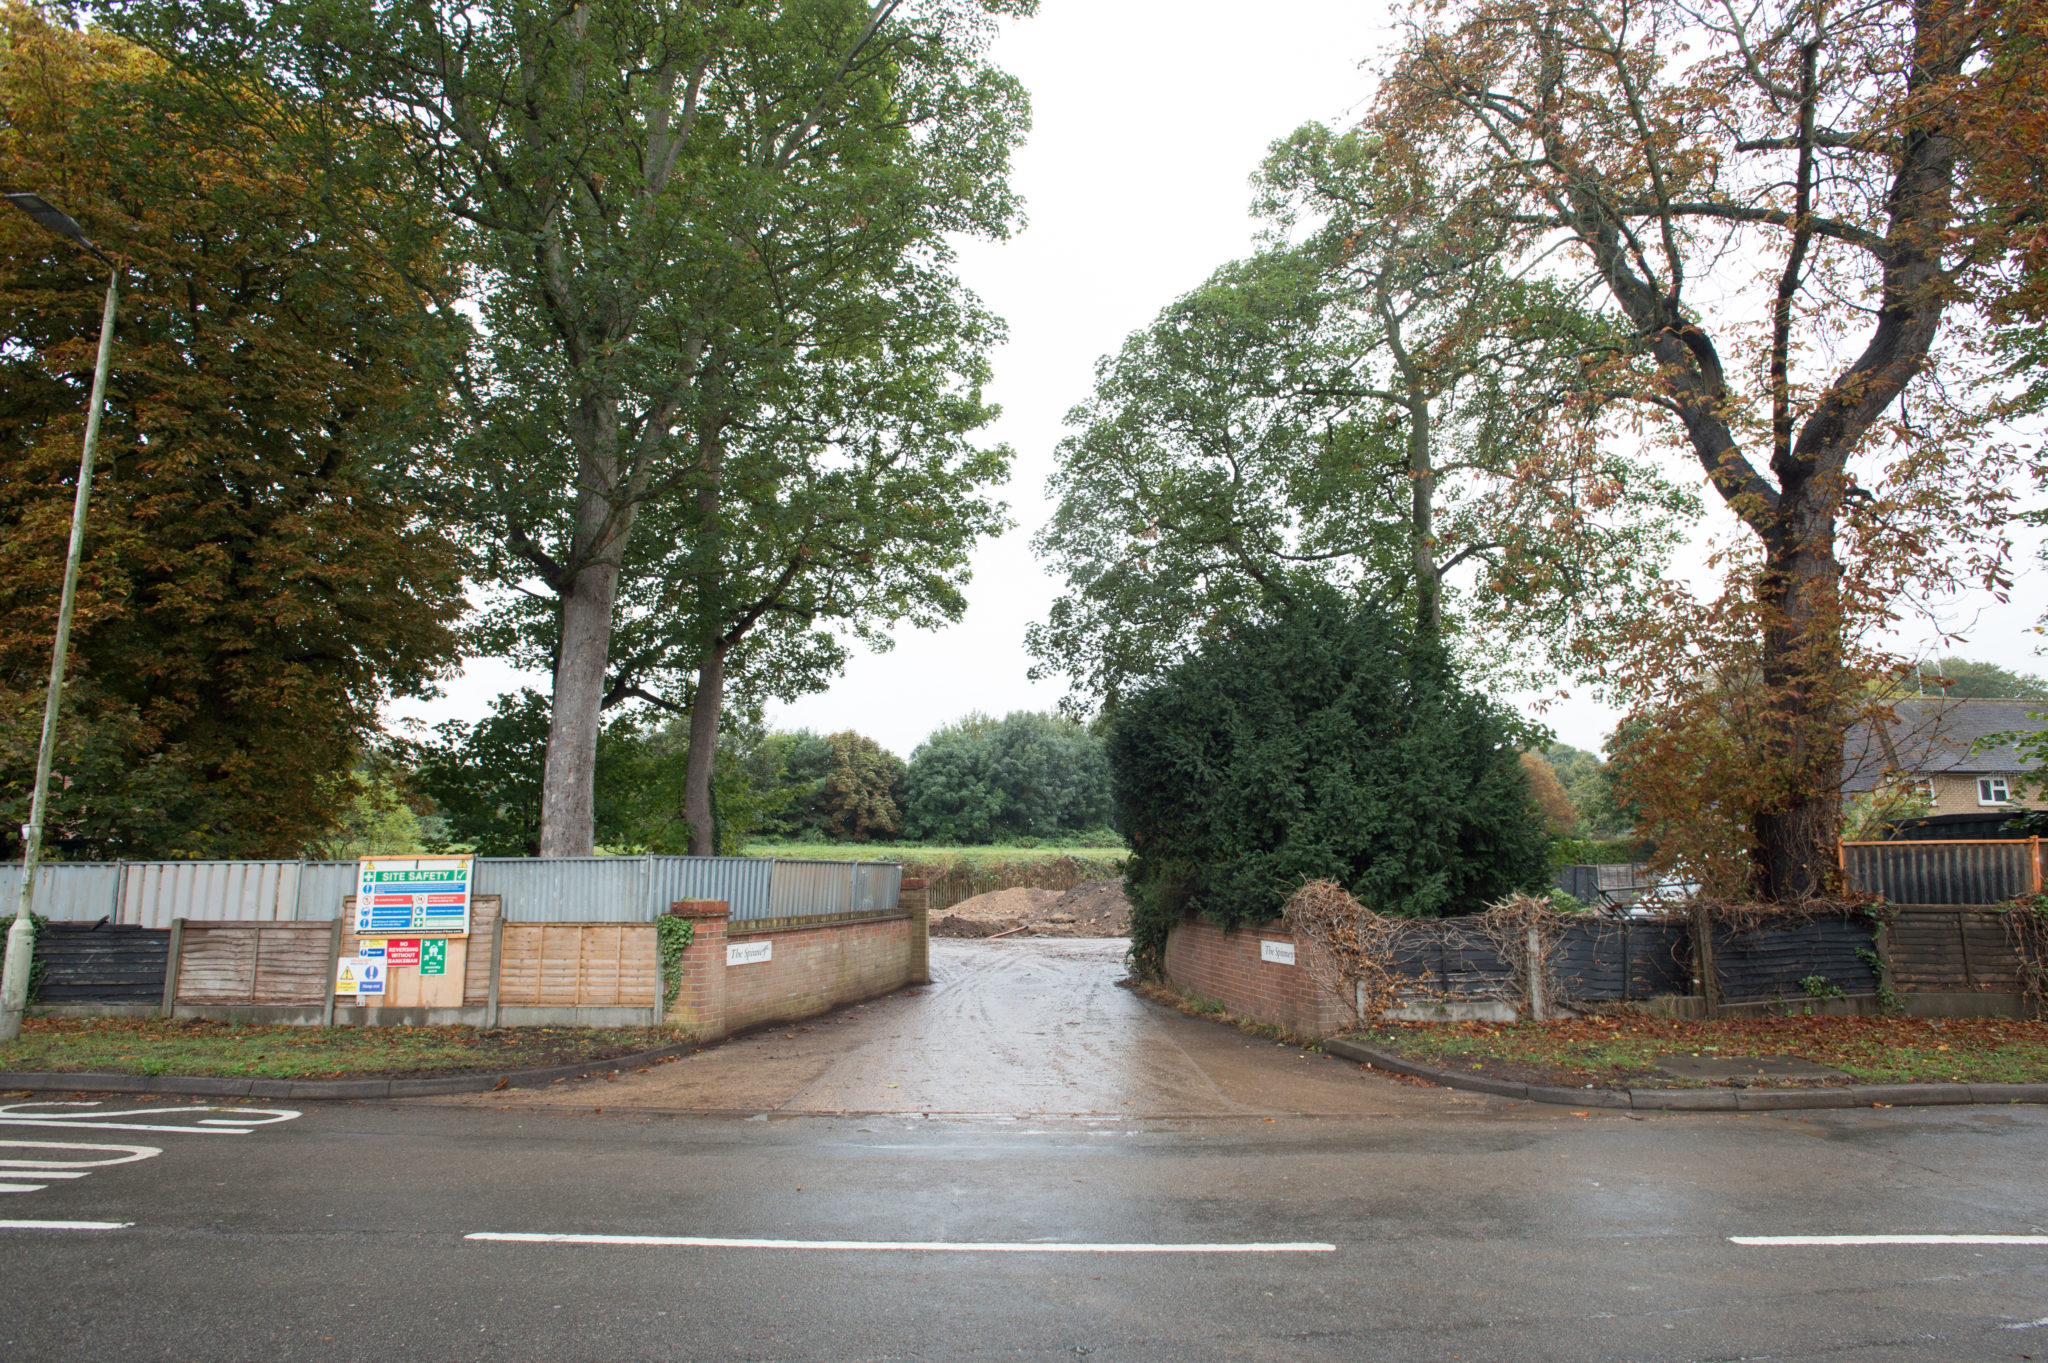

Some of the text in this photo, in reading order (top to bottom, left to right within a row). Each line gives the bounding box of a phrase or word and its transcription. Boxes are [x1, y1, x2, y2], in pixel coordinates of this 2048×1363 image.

[383, 871, 449, 881] SITE SAFETY
[731, 948, 743, 959] The
